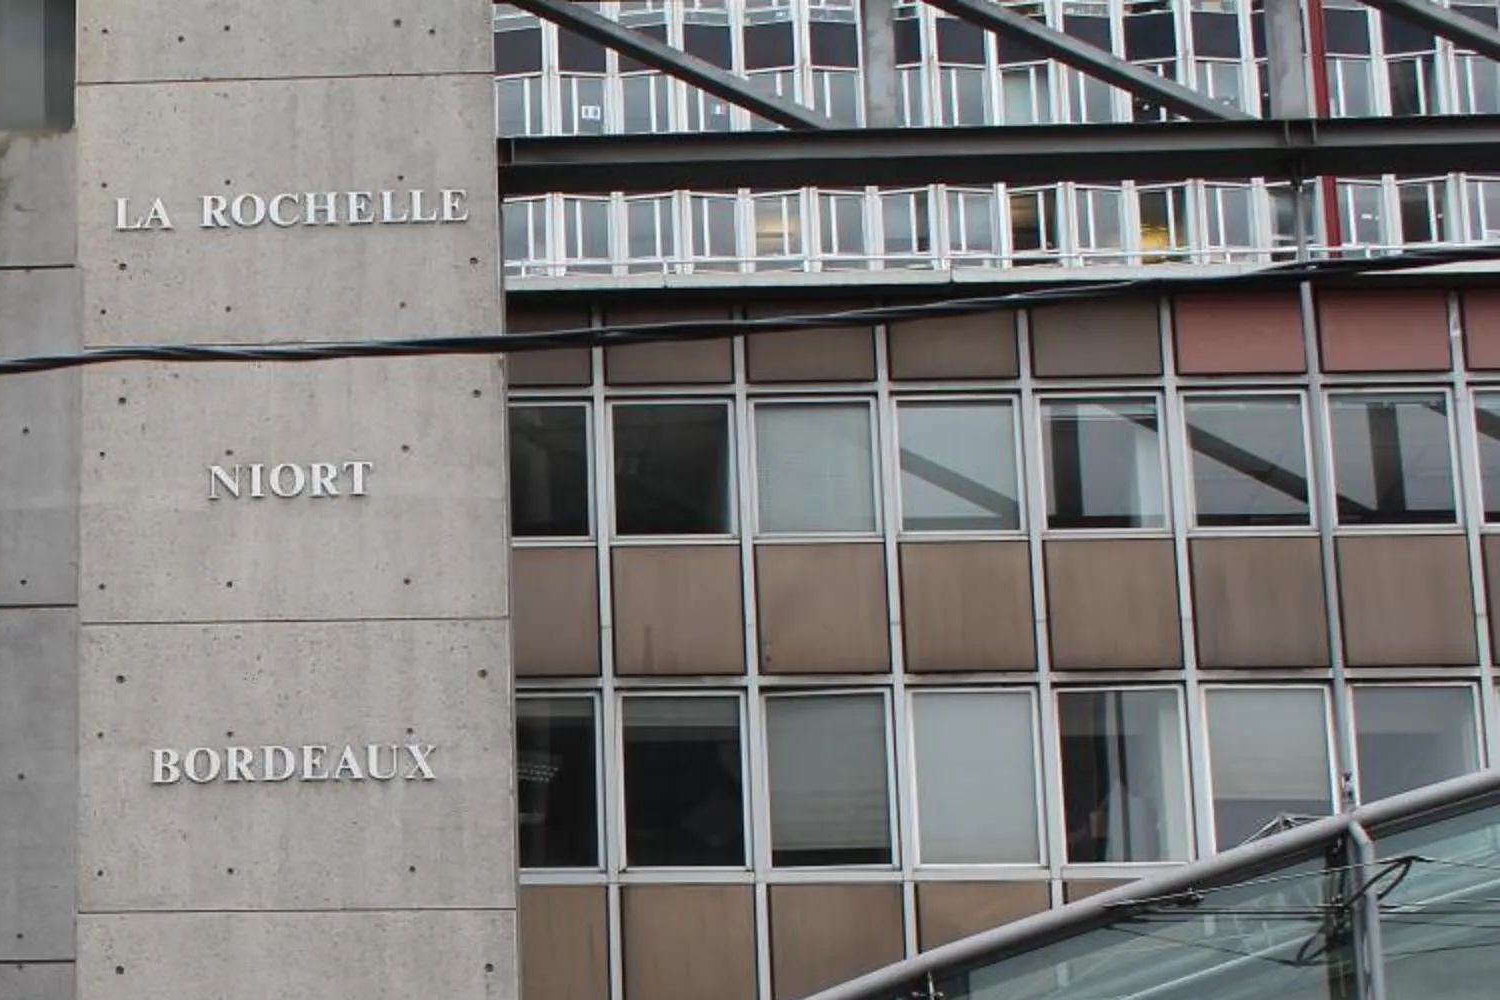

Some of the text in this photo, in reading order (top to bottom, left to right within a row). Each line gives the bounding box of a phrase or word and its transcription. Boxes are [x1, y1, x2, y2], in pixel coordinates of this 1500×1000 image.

[116, 188, 469, 229] LA ROCHELLE
[209, 461, 370, 498] NIORT
[153, 745, 437, 783] BORDEAUX
